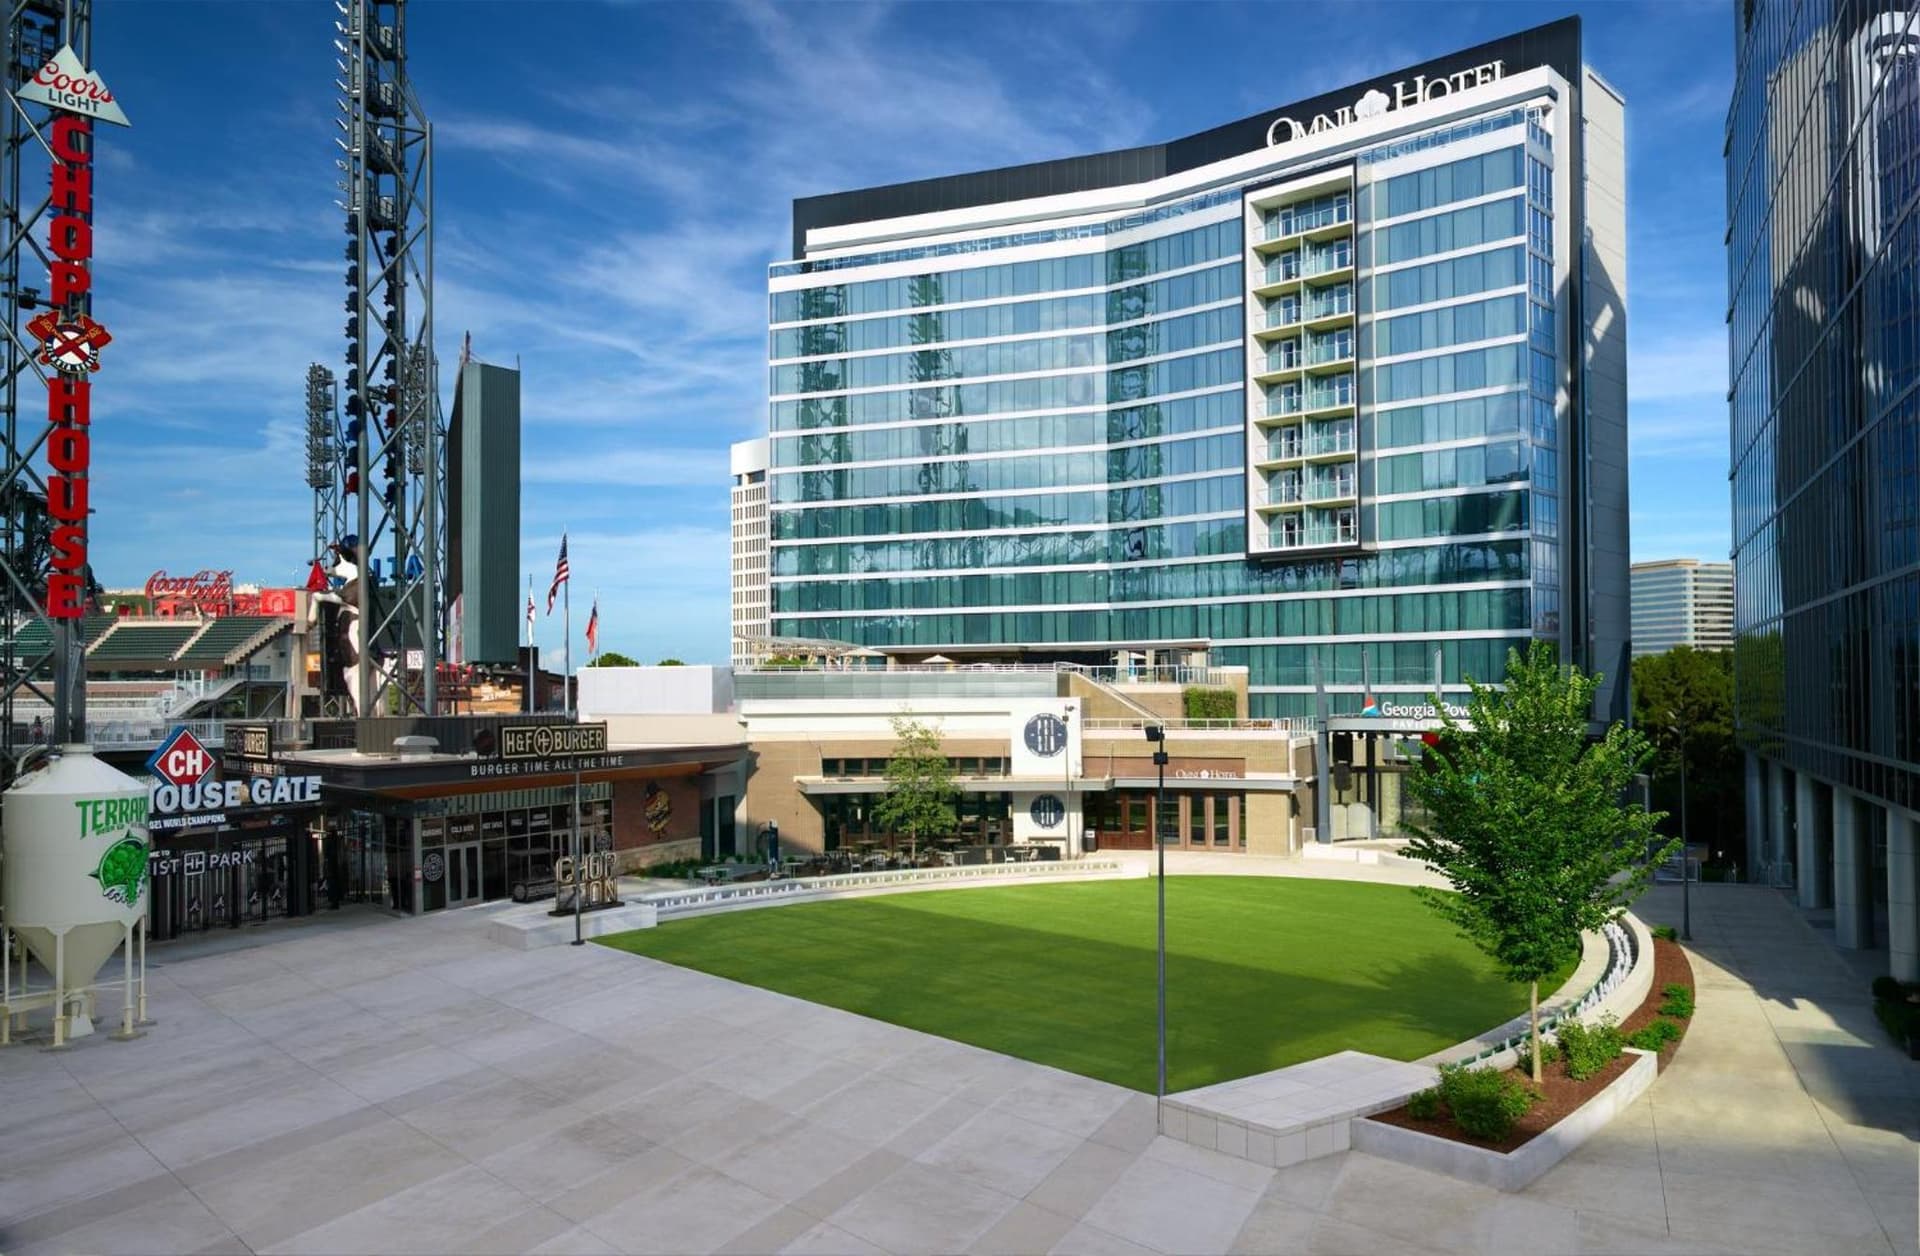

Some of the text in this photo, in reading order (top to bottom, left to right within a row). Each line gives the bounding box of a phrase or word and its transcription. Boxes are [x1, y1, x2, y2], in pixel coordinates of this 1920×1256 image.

[33, 61, 112, 103] Coors
[1393, 59, 1504, 111] HOTEL
[48, 87, 100, 113] LIGHT
[50, 115, 92, 305] CHOP
[47, 377, 91, 618] HOUSE
[1381, 701, 1436, 721] Georgia
[506, 732, 533, 753] H&F
[554, 729, 604, 751] BURGER
[167, 749, 203, 777] CH
[471, 755, 624, 776] BURGER TIME ALL THE TIME
[251, 776, 323, 805] GATE
[75, 796, 149, 840] TERRAP
[163, 817, 187, 829] WORLD
[187, 813, 226, 827] CHAMPIONS
[152, 858, 180, 876] IST
[210, 849, 253, 868] PARK
